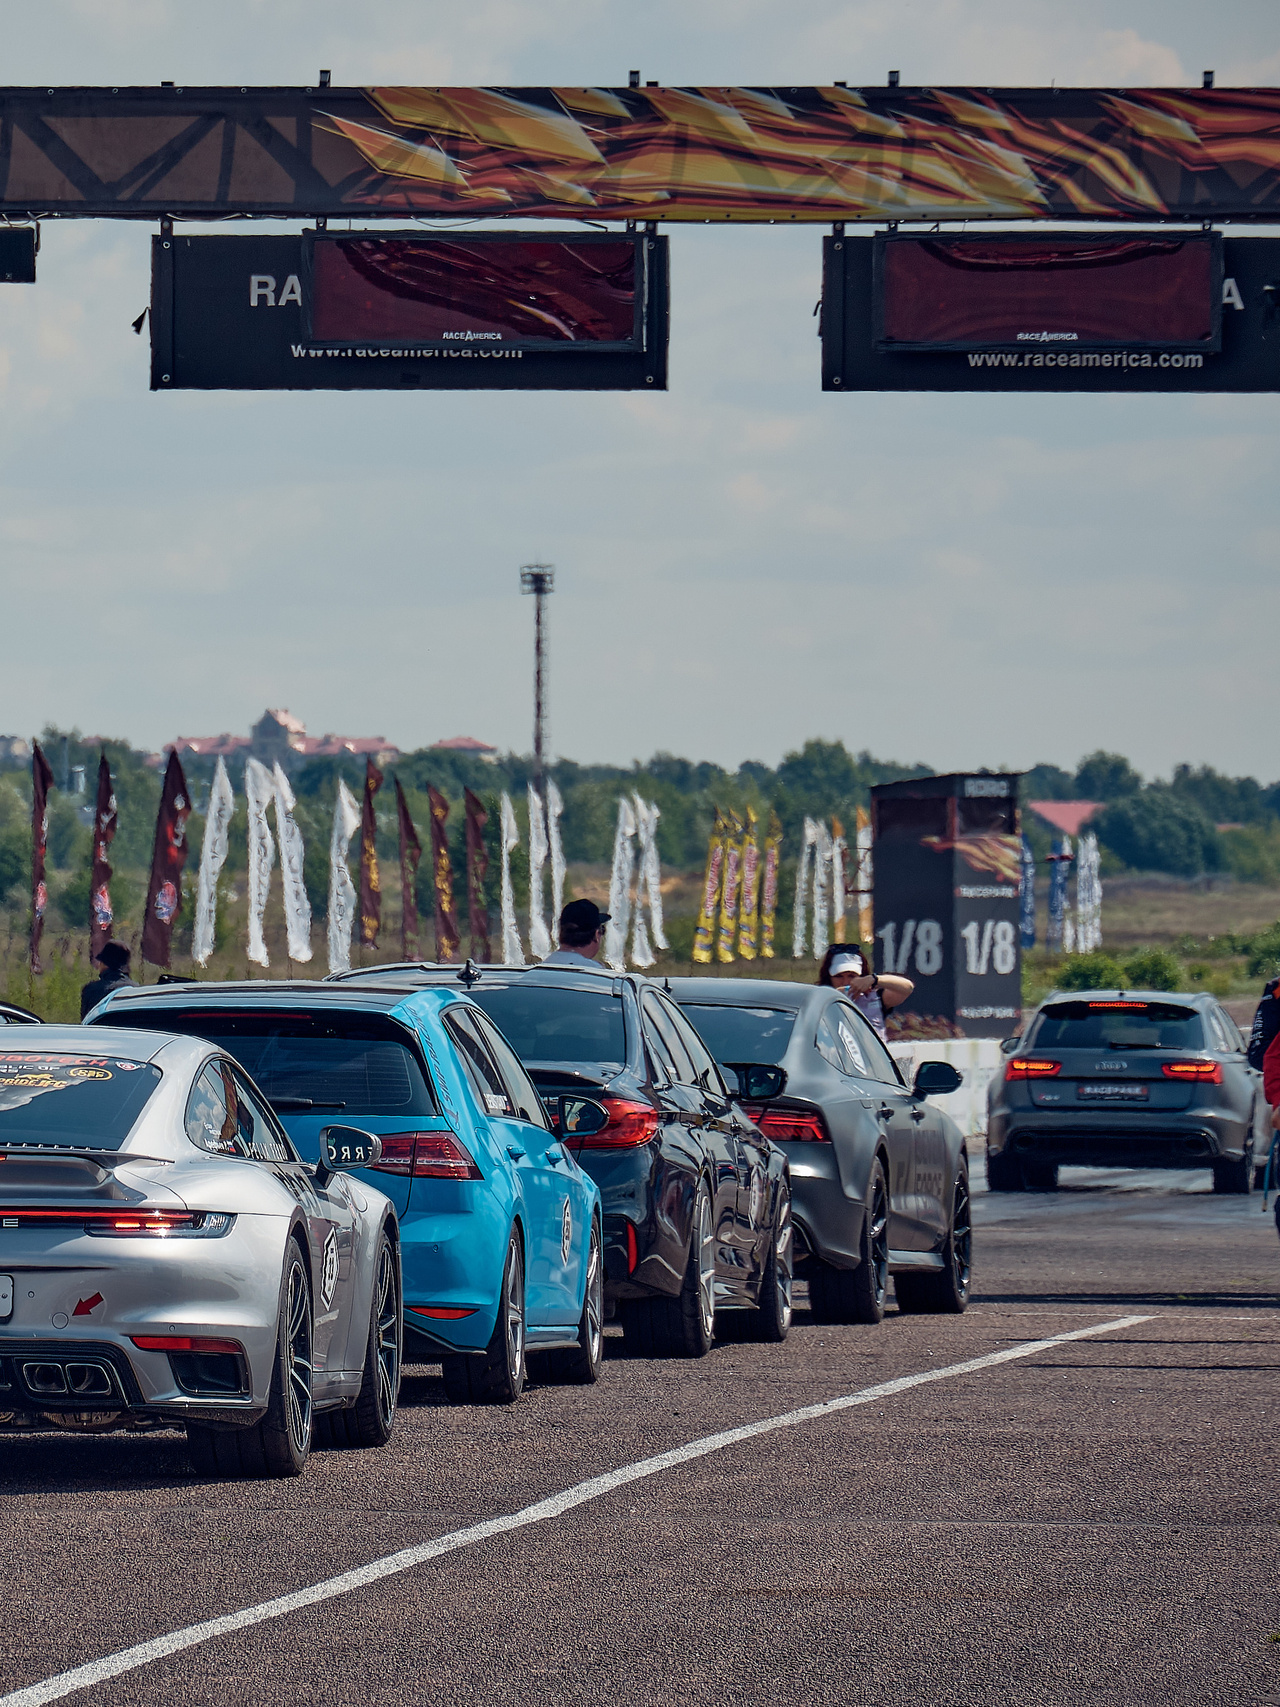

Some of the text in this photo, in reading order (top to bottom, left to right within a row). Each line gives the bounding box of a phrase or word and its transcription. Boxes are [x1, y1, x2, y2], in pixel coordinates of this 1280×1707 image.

[967, 351, 1204, 368] www.raceamerica.com
[876, 919, 943, 975] 1/8
[961, 919, 1016, 975] 1/8
